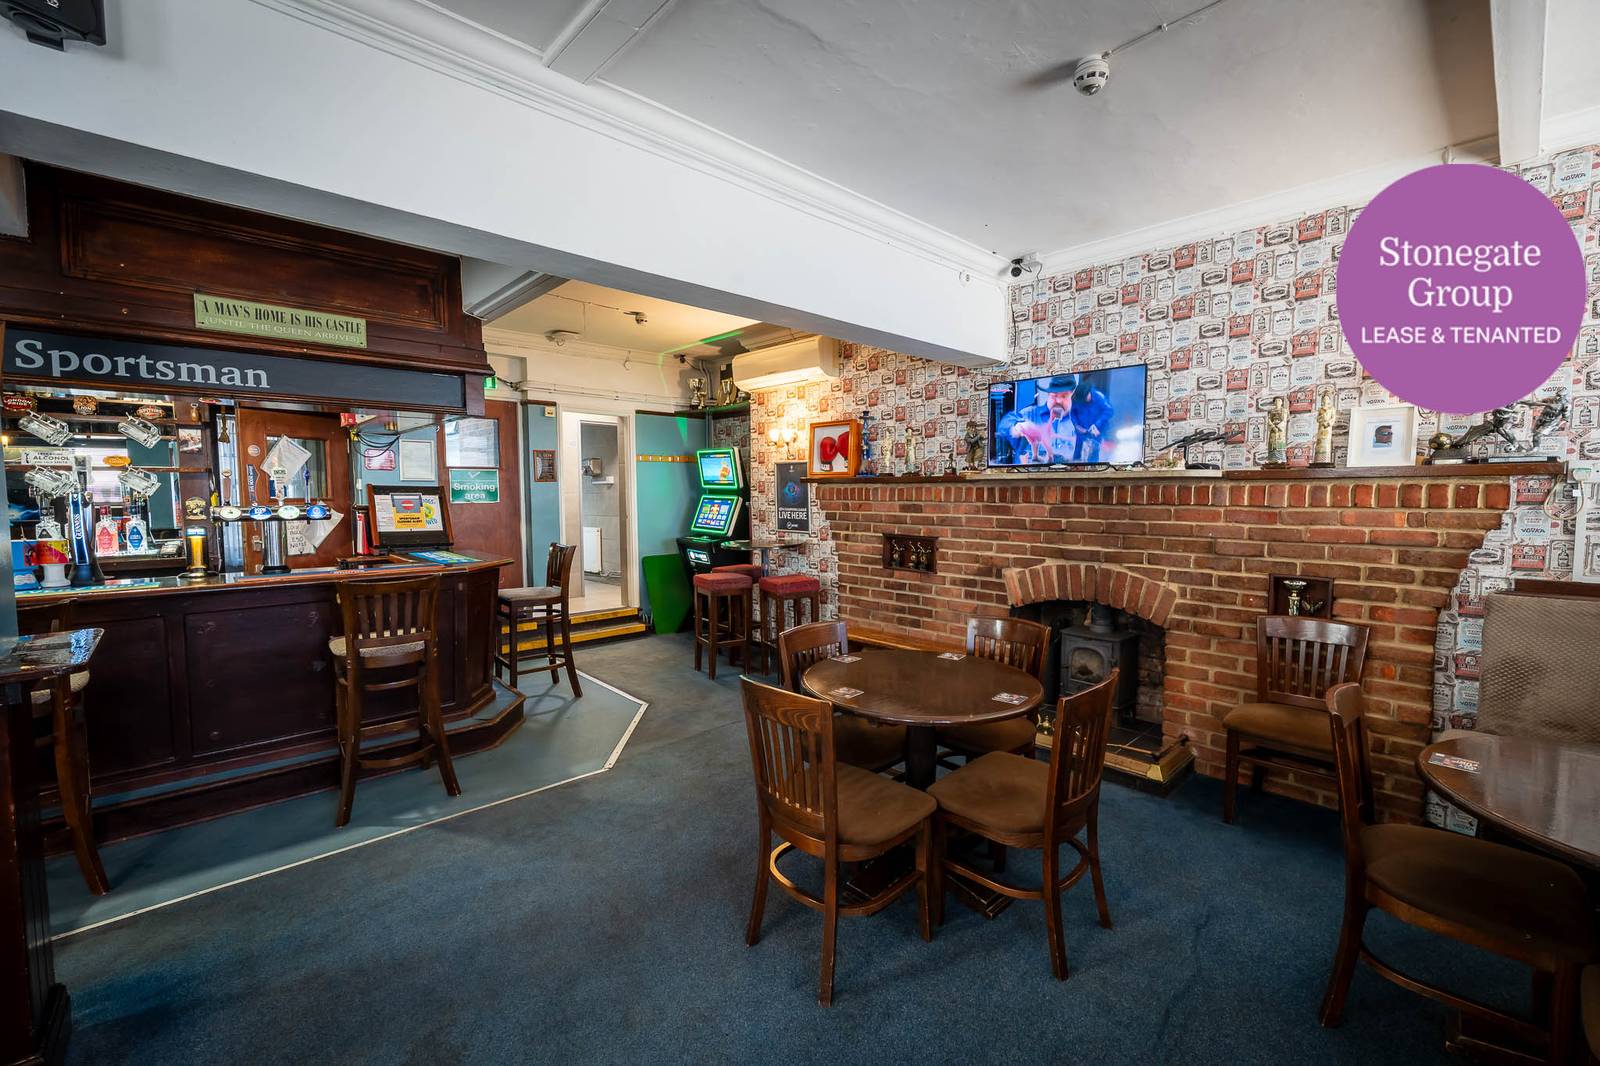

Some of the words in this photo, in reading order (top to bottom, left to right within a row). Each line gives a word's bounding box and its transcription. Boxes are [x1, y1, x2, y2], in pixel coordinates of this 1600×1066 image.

[200, 299, 209, 313] A
[214, 301, 251, 318] MAN'S
[255, 307, 287, 325] HOME
[290, 313, 301, 326] IS
[304, 314, 323, 328] HIS
[325, 318, 362, 335] CASTLE
[250, 322, 272, 332] THE
[273, 325, 312, 338] QUEEN
[15, 339, 271, 388] Sportsman
[453, 482, 496, 492] Smoking
[464, 492, 486, 500] area
[778, 511, 791, 520] LIVE
[791, 511, 808, 520] HERE
